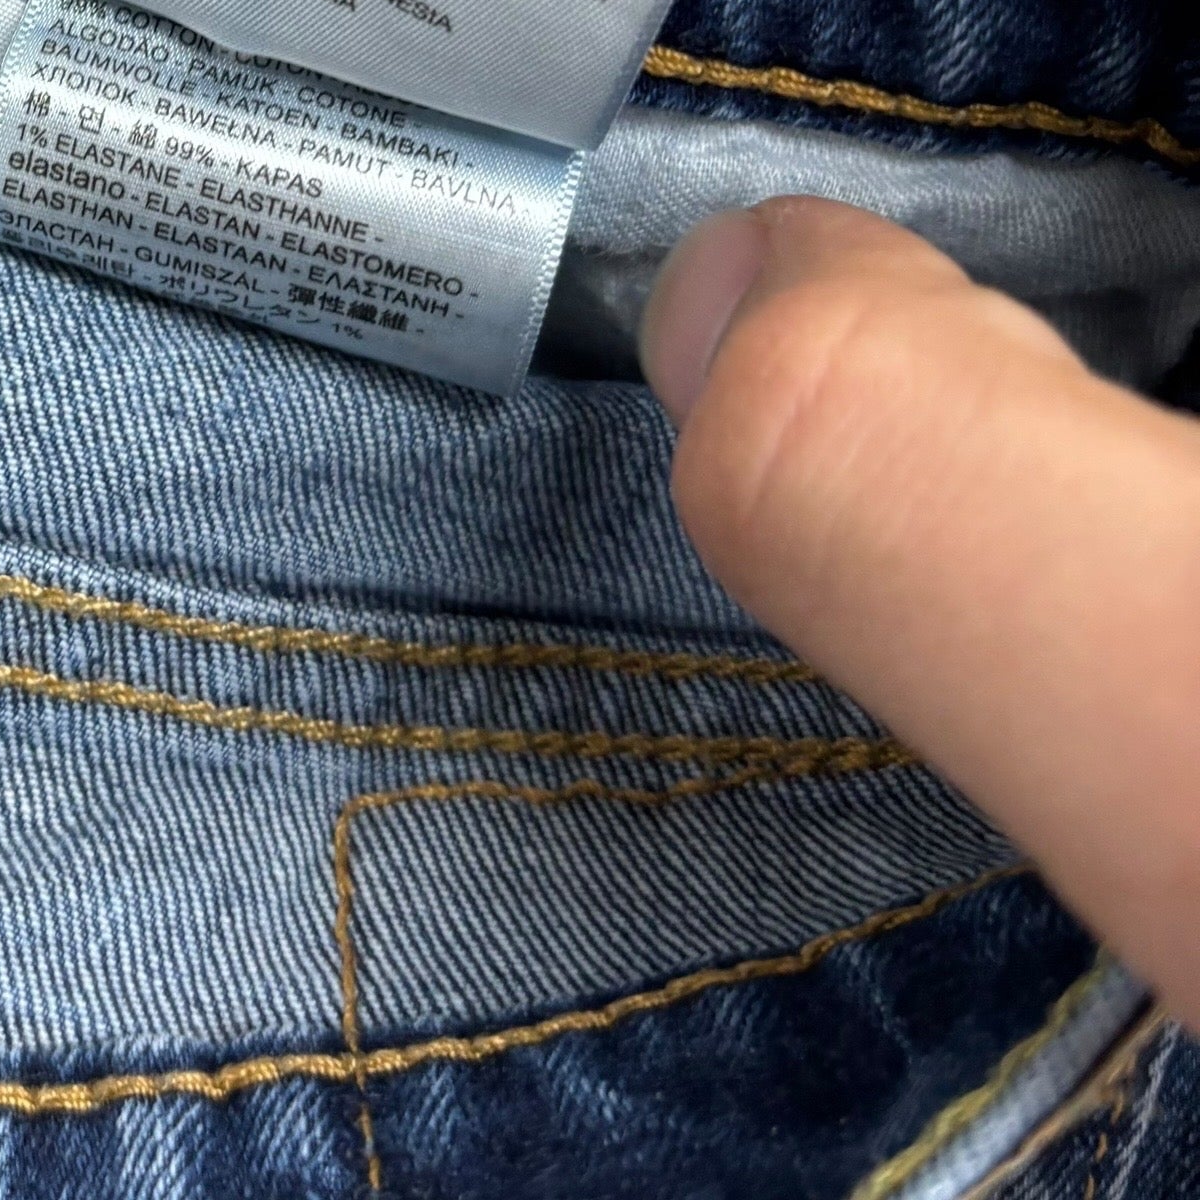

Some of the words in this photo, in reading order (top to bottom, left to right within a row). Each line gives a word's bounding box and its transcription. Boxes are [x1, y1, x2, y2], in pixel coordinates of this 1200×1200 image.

[114, 5, 215, 54] COTTON
[40, 38, 198, 97] BAUMWOLLE
[215, 91, 321, 131] KATOEN
[187, 58, 278, 97] PAMUK
[296, 85, 408, 129] COTONE
[16, 122, 49, 149] 1%
[54, 132, 182, 189] ELASTANE
[199, 177, 370, 244] ELASTHANNE
[154, 97, 277, 149] BAWEŁNA
[298, 138, 393, 178] PAMUT
[410, 168, 515, 218] BAVLNA
[165, 135, 214, 168] 99%
[235, 156, 324, 199] KAPAS
[1, 177, 134, 231] ELASTHAN
[152, 220, 288, 275] ELASTAAN
[7, 149, 126, 201] elastano
[144, 191, 262, 242] ELASTAN
[279, 230, 464, 297] ELASTOMERO
[331, 322, 364, 341] 1%
